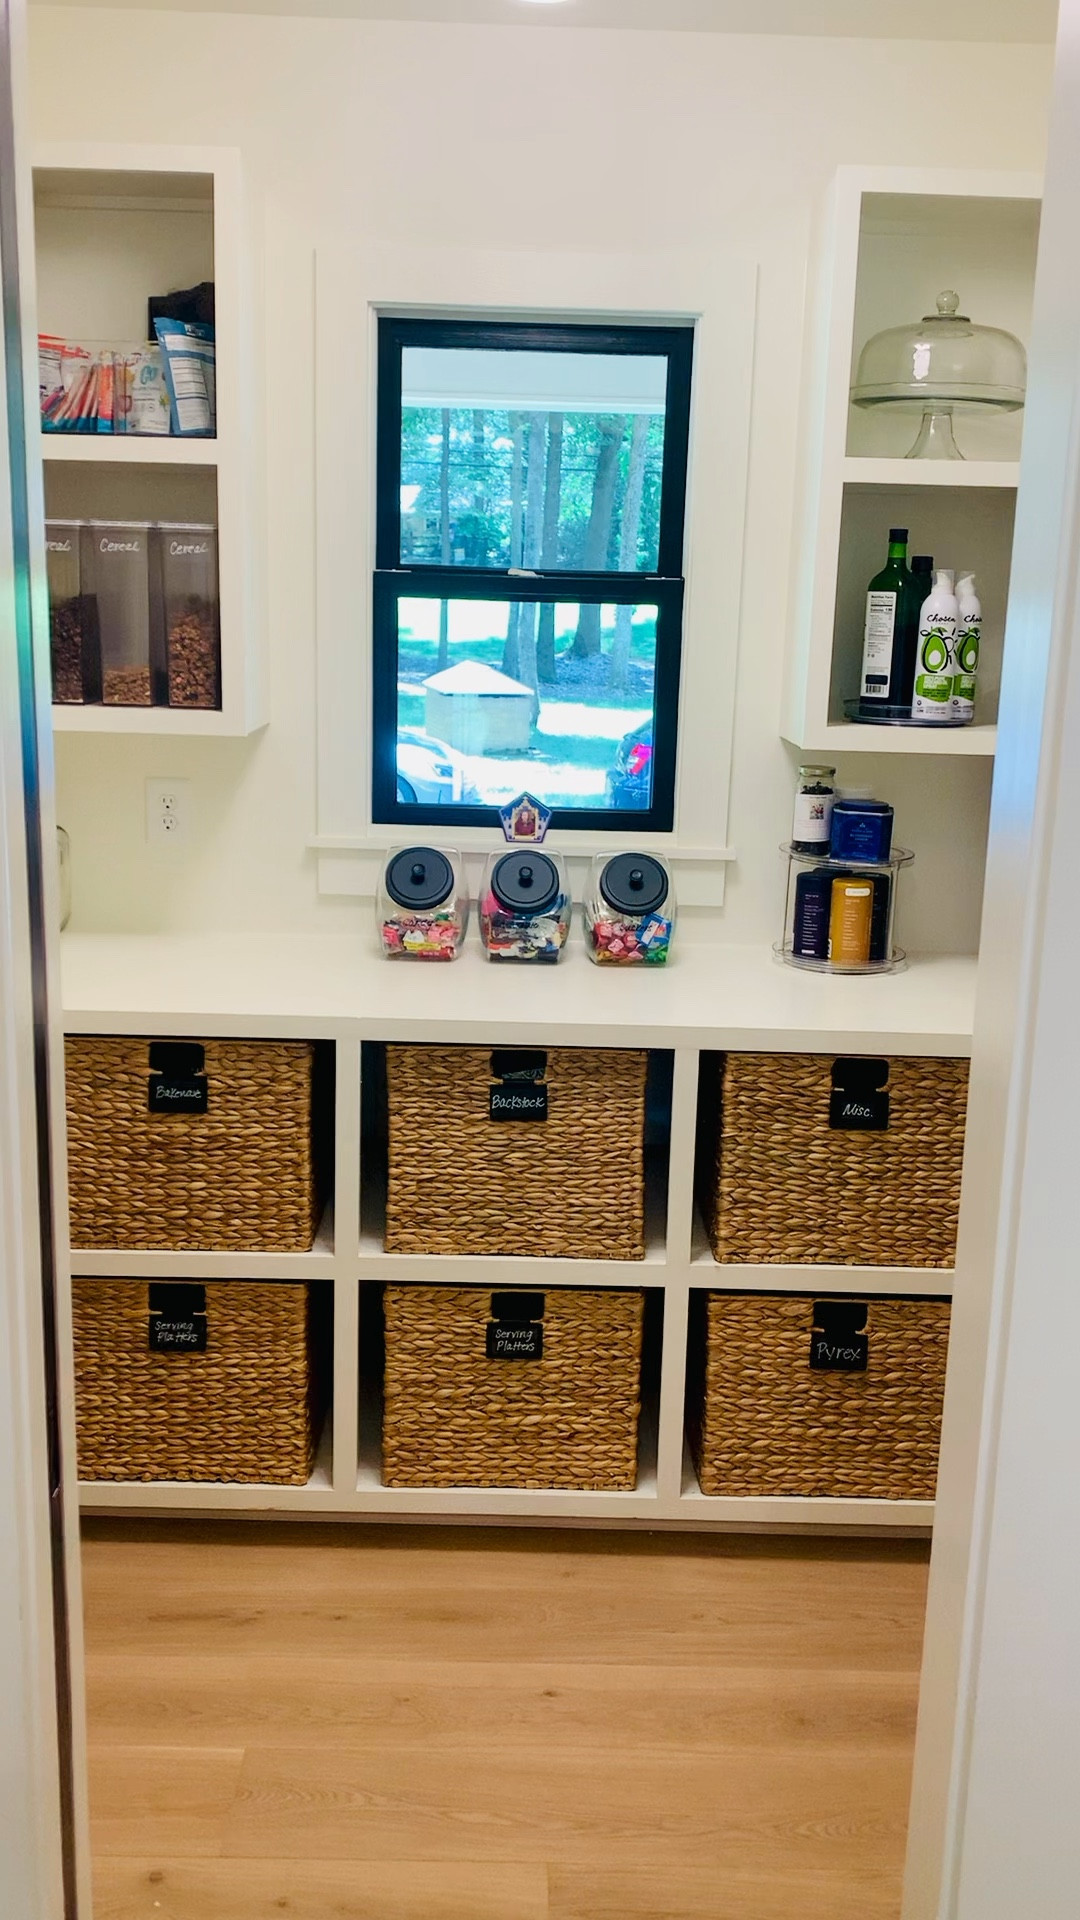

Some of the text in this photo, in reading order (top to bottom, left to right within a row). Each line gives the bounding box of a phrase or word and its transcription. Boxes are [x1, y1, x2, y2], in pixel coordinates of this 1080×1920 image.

[100, 538, 140, 552] Cereal
[170, 542, 208, 555] Cereal
[927, 613, 956, 623] Chosen
[491, 1094, 545, 1109] Backstock
[842, 1103, 873, 1117] Misc.
[154, 1321, 193, 1334] Serving
[157, 1332, 199, 1343] Platters
[495, 1329, 533, 1343] Serving
[496, 1340, 535, 1352] Platters
[816, 1342, 861, 1361] Pyrex
